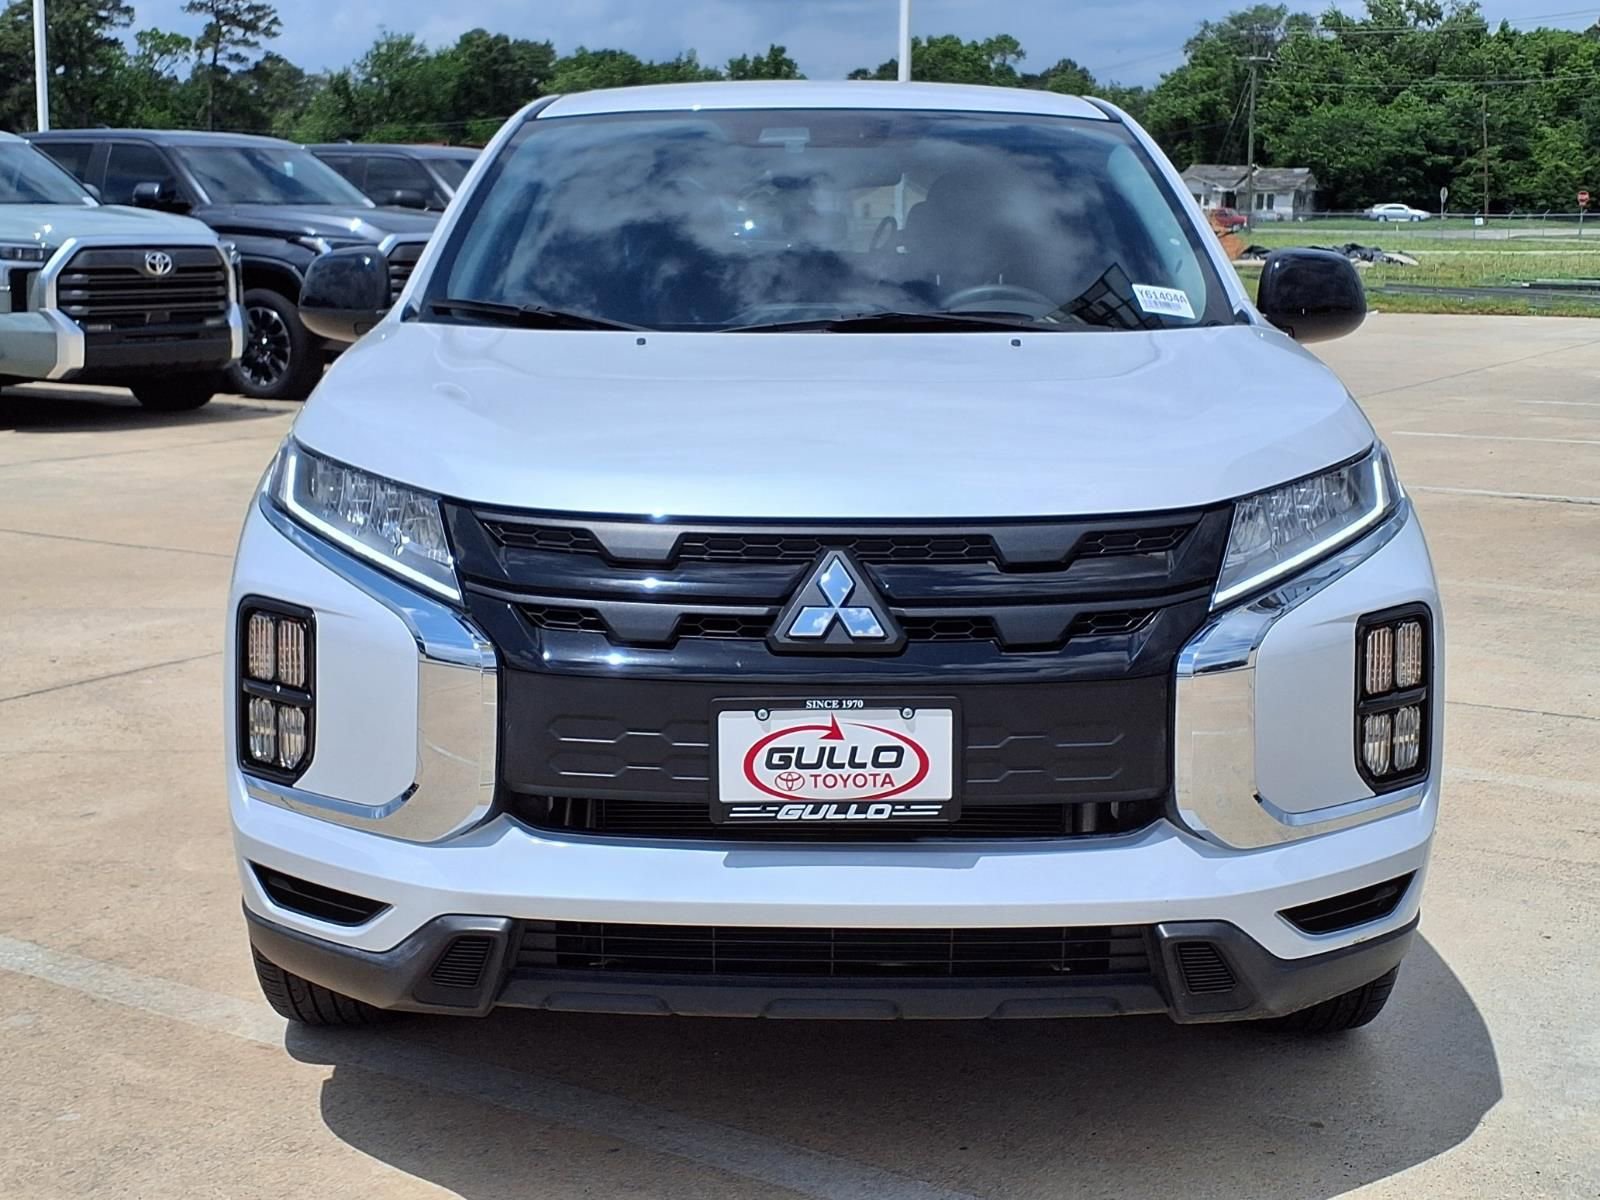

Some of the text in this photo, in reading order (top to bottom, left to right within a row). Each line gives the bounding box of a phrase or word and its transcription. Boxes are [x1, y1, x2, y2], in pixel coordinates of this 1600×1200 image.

[806, 699, 864, 709] SINCE 1970
[765, 745, 904, 770] GULLO
[810, 773, 895, 788] TOYOTA
[777, 804, 892, 819] GULLO
